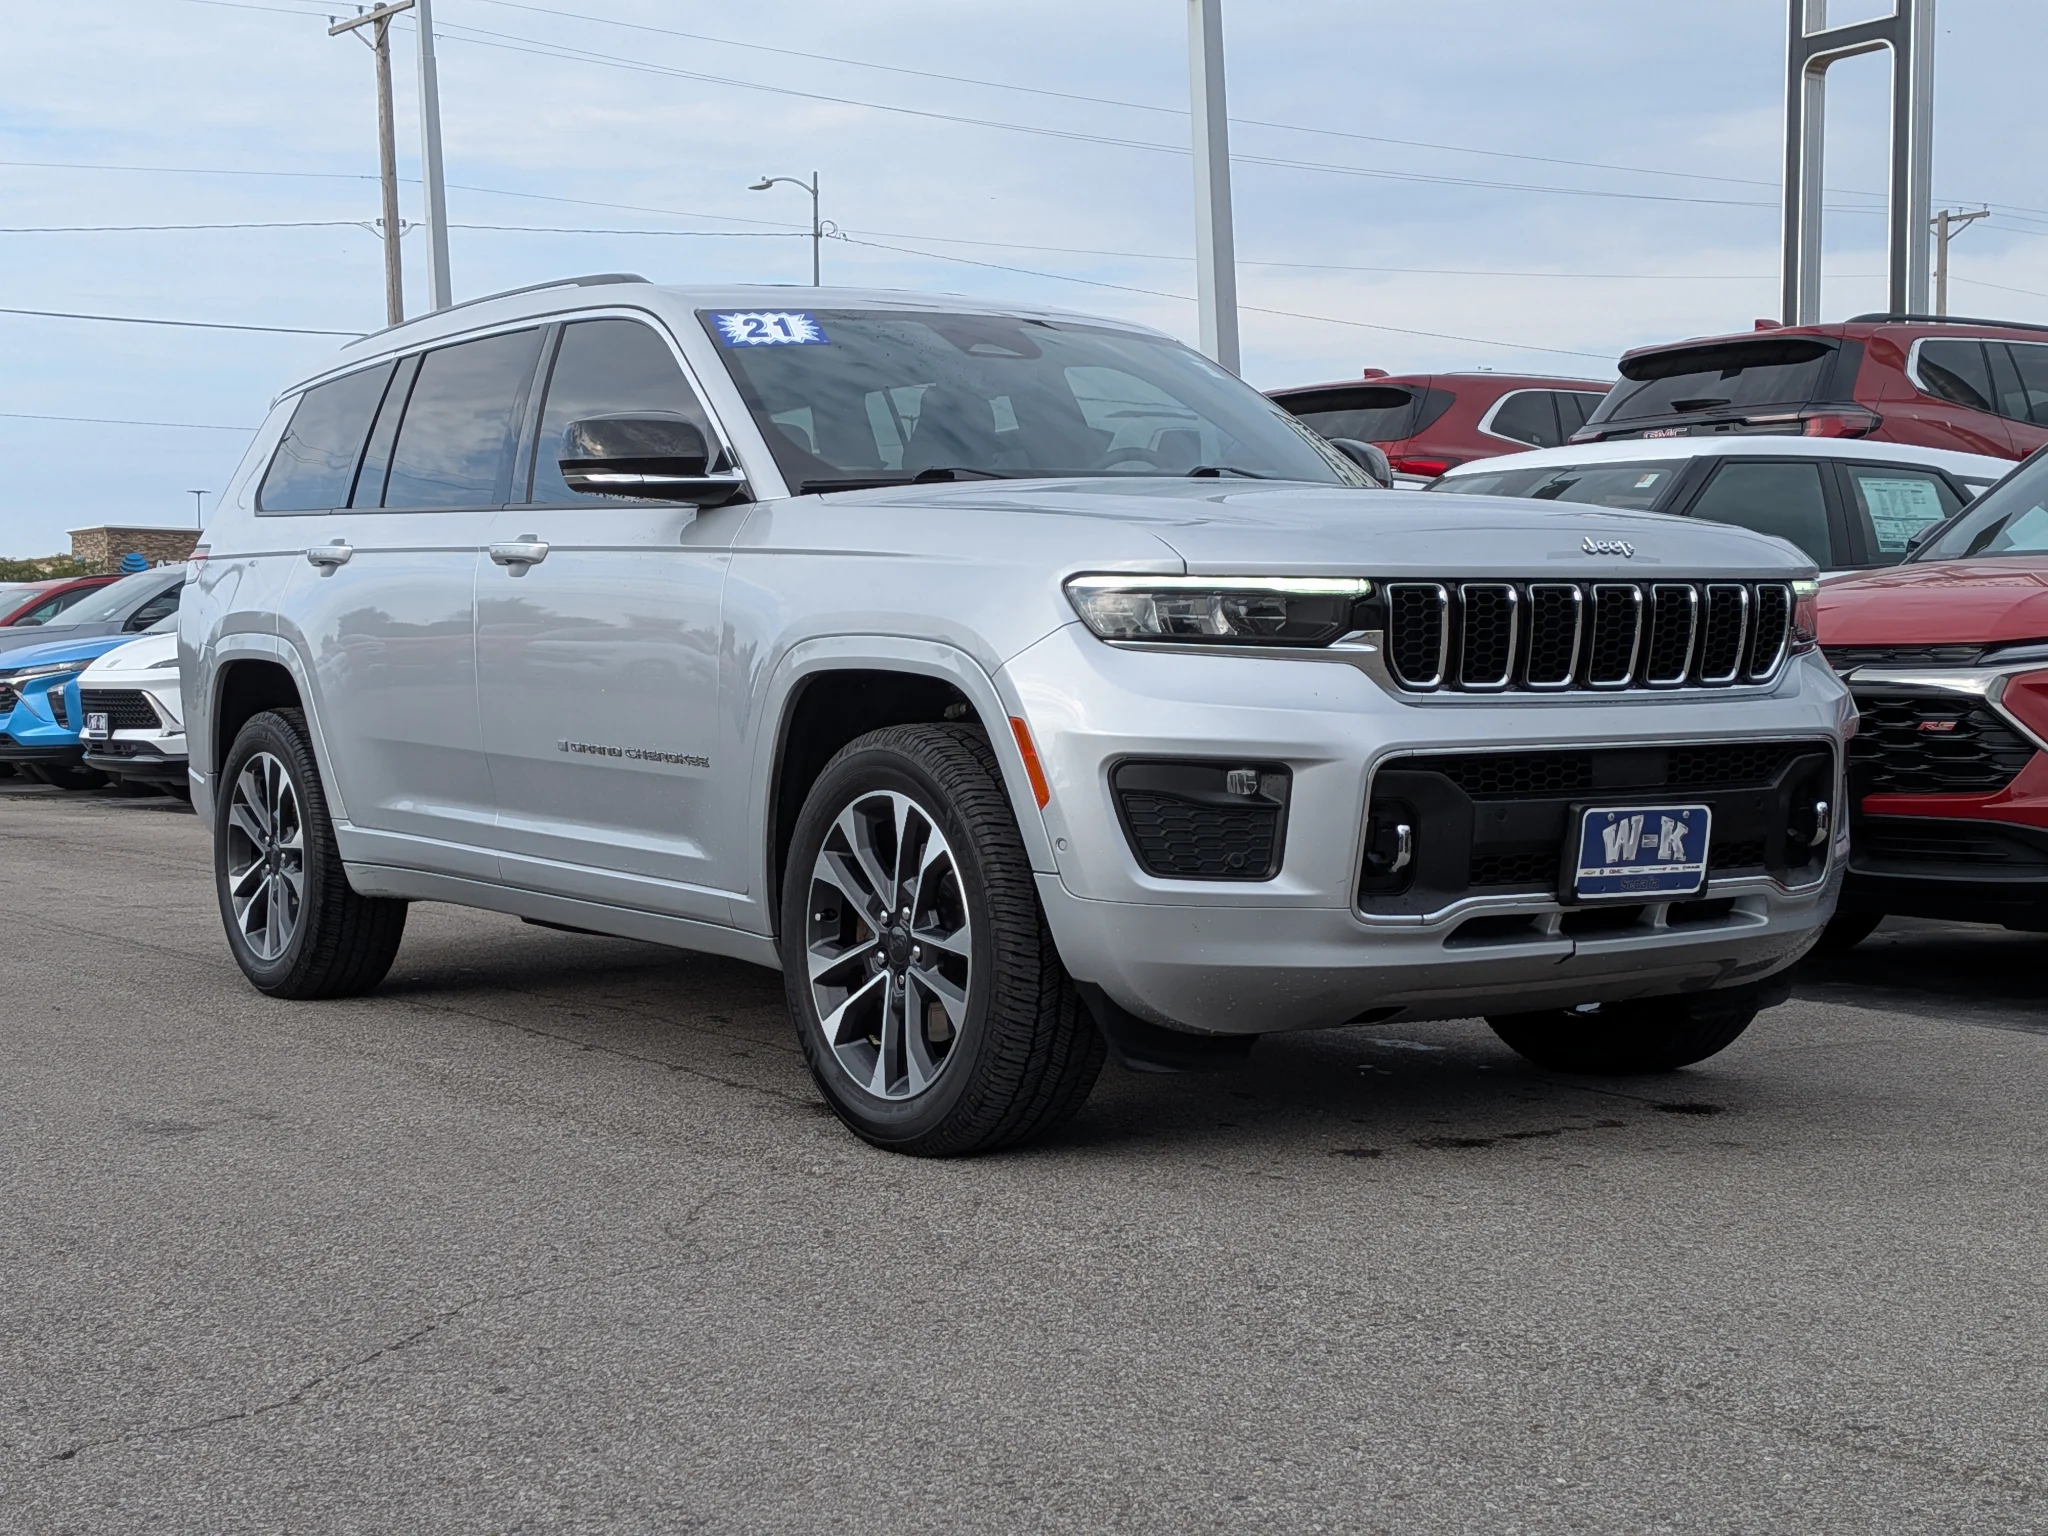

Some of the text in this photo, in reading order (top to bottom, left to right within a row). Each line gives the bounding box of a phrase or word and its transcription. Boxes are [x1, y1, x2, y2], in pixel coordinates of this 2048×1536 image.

[742, 317, 795, 338] 21
[1643, 427, 1688, 439] GMC
[1581, 536, 1635, 558] Jeep
[1918, 721, 1957, 731] RS
[570, 741, 710, 768] GRAND CHEROKEE
[1602, 814, 1689, 864] W-K
